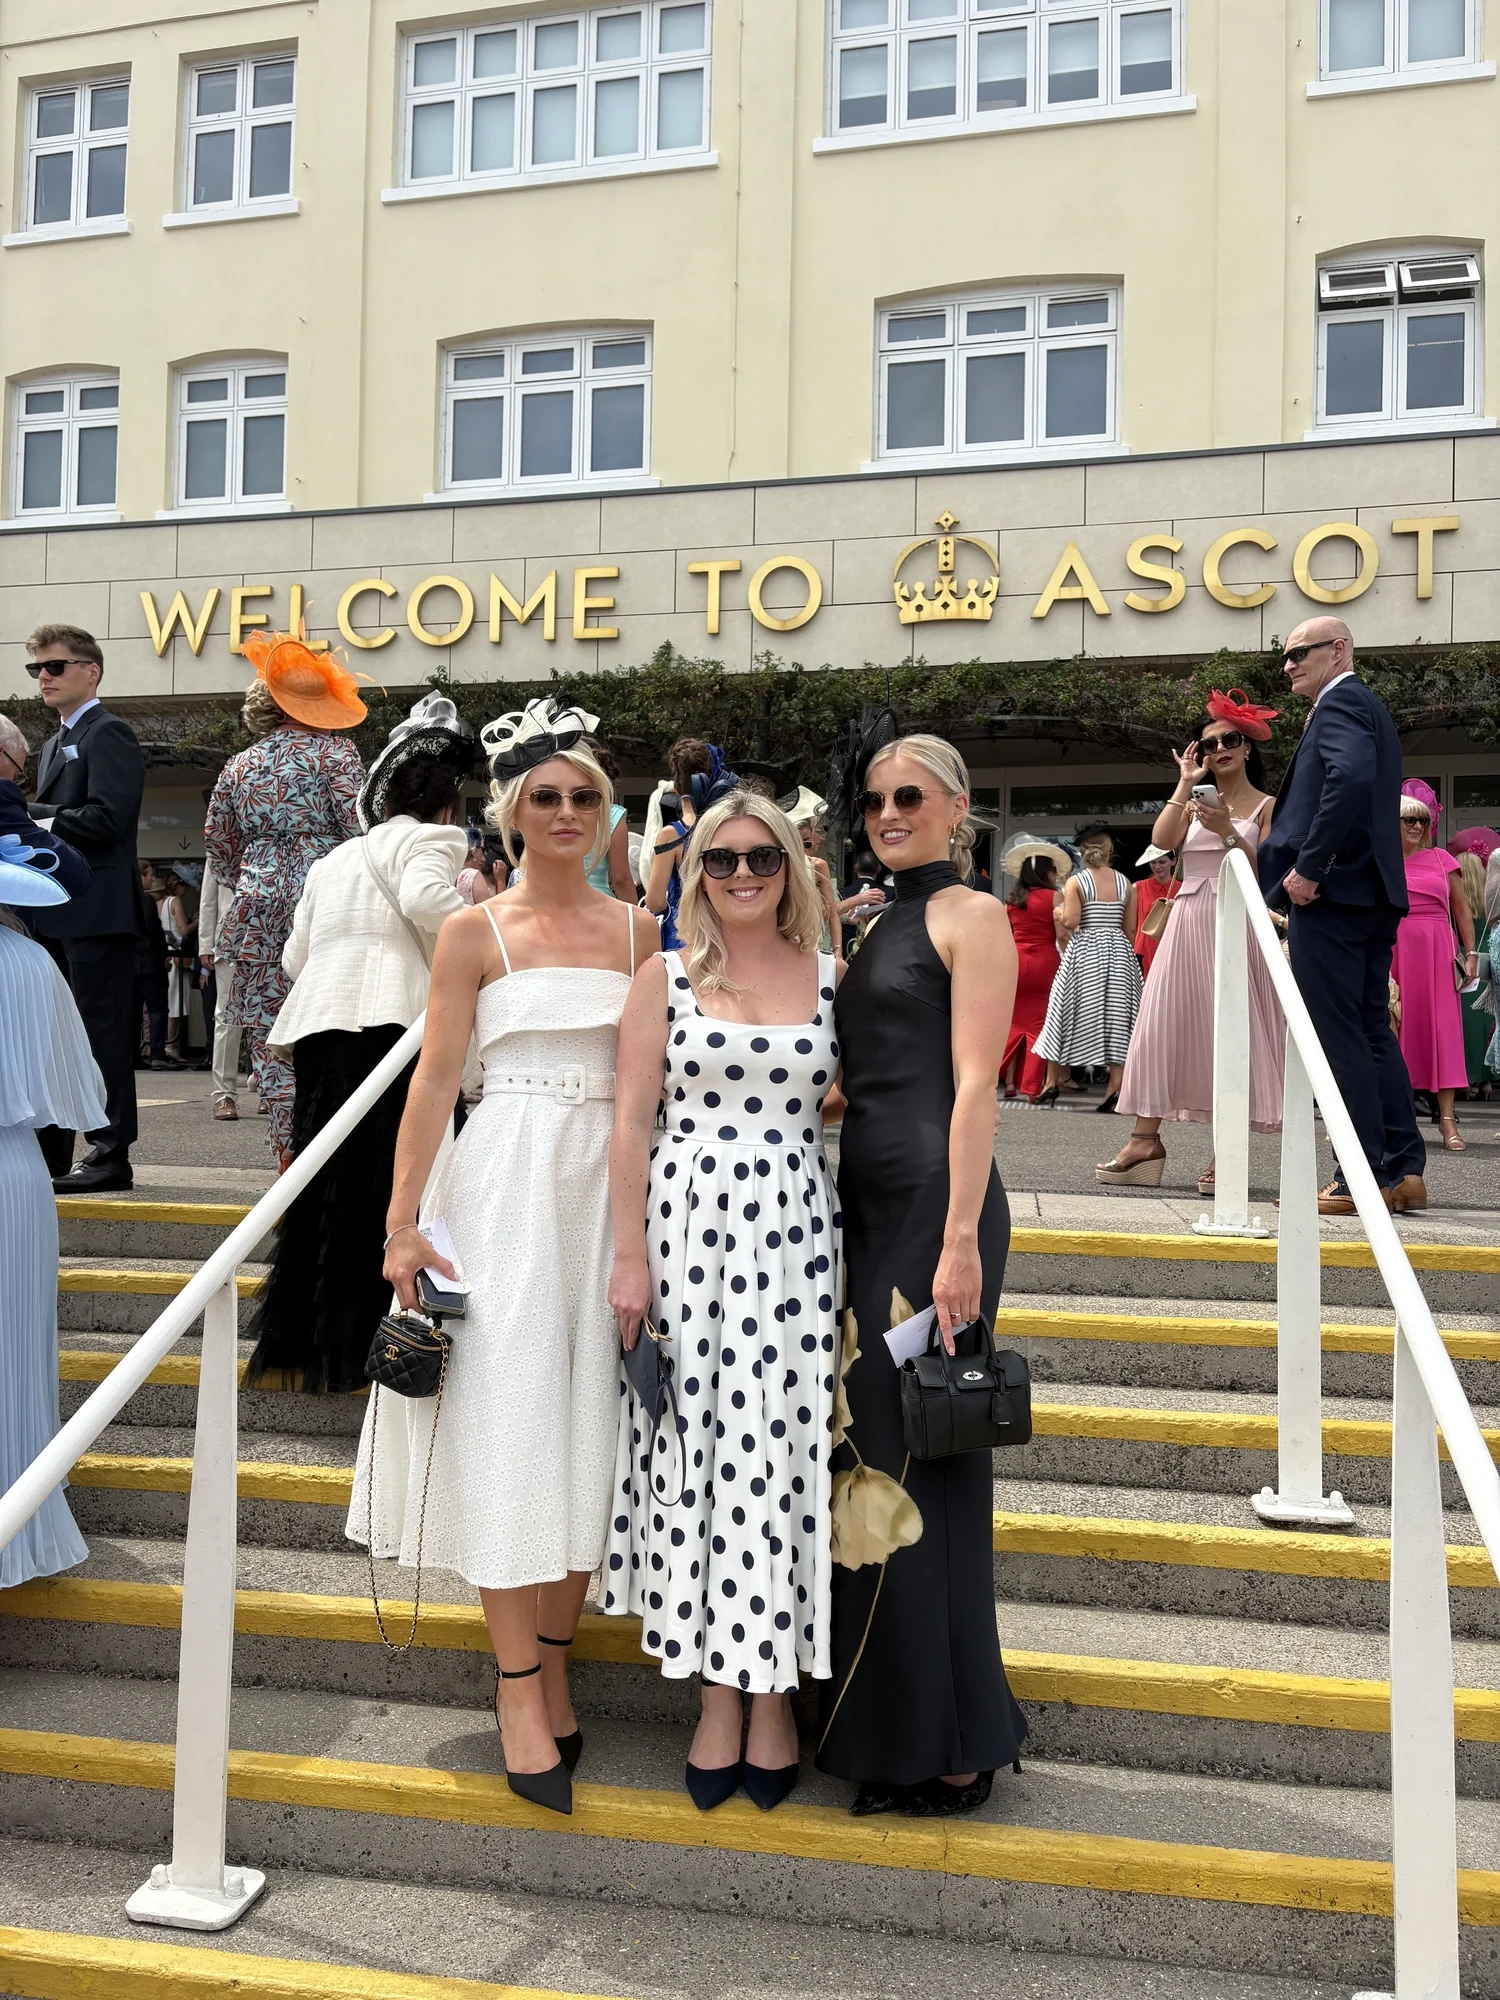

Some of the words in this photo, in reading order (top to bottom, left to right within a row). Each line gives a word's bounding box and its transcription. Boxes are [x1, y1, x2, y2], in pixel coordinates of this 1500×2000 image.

[139, 566, 620, 658] WELCOME
[687, 555, 823, 634] TO
[1030, 515, 1460, 619] ASCOT
